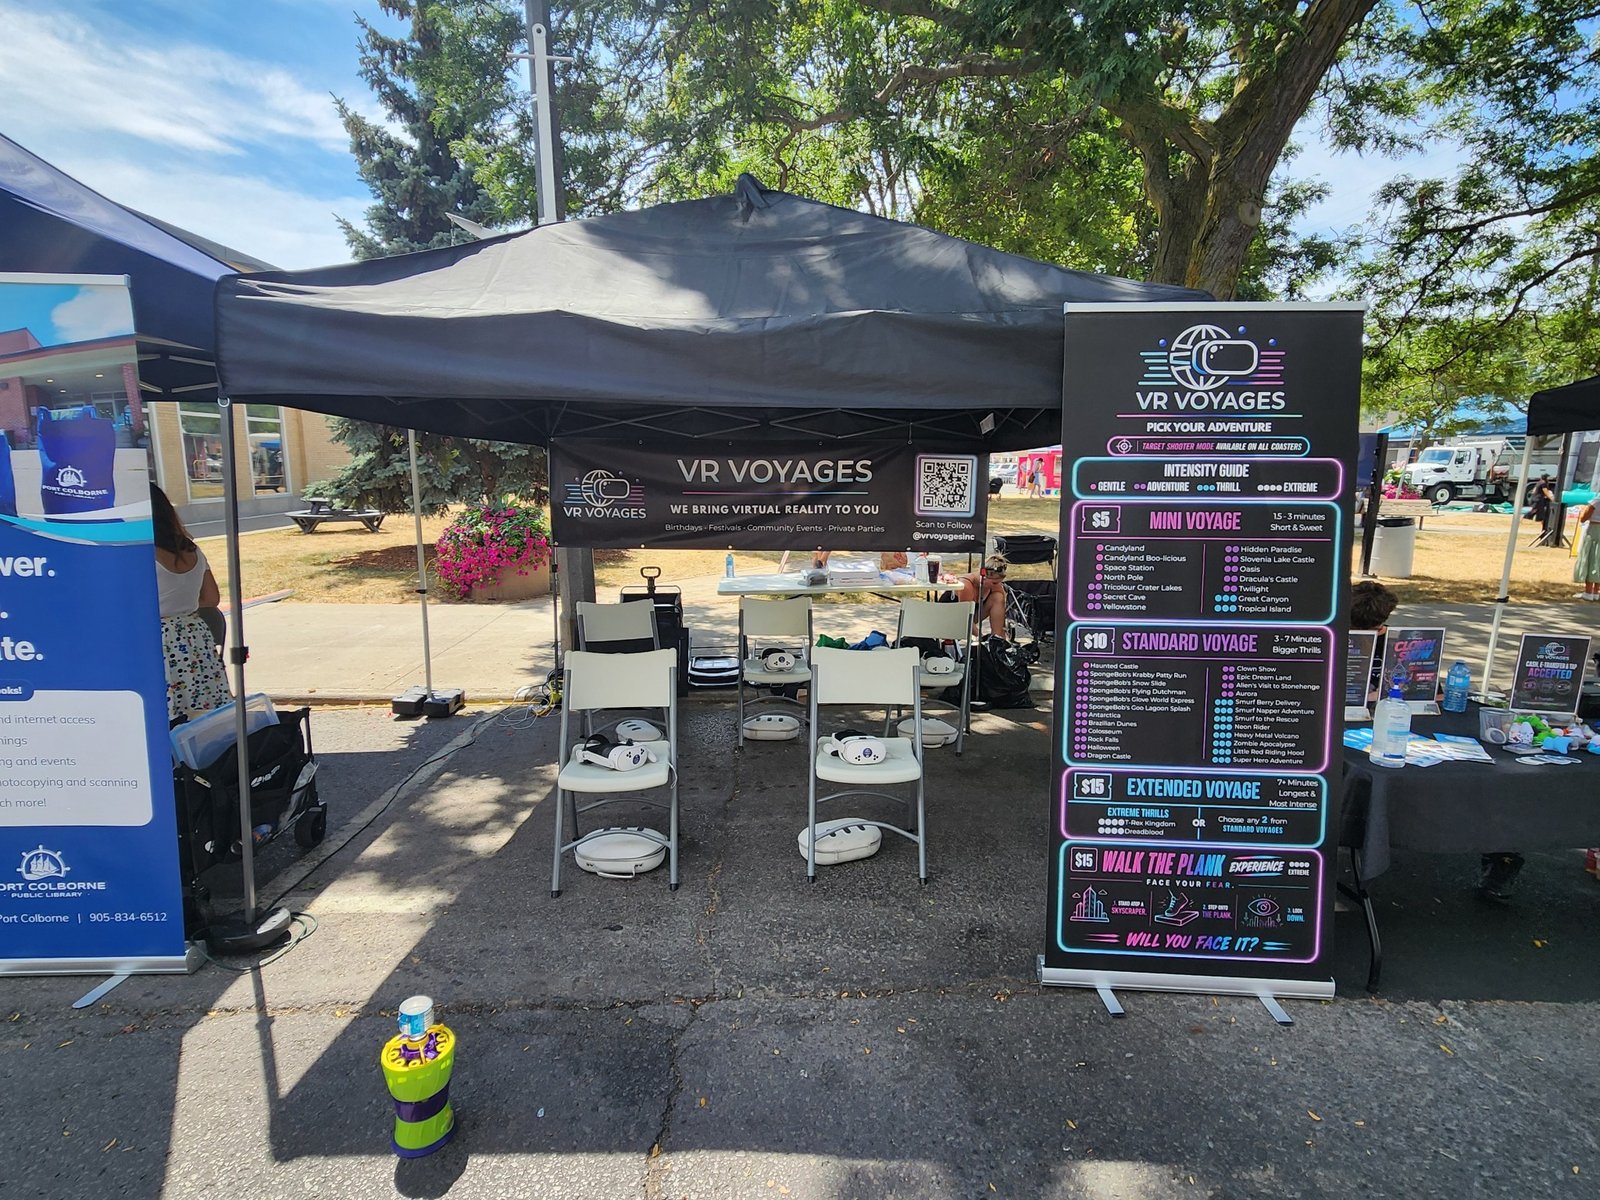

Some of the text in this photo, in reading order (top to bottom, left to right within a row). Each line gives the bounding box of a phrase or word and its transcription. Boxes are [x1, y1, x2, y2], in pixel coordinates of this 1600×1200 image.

[1135, 391, 1285, 409] VR VOYAGES
[1146, 422, 1272, 432] PICK YOUR ADVENTURE
[1142, 442, 1302, 450] TARGET SHOOTER MODE AVAILABLE ON ALL COASTERS
[677, 459, 872, 483] VR VOYAGES
[1164, 463, 1249, 477] INTENSITY GUIDE
[1098, 481, 1318, 492] GENTLE ADVENTURE THRILL EXTREME
[563, 506, 646, 519] VR VOYAGES
[670, 504, 879, 514] WE BRING VIRTUAL REALITY TO YOU
[1092, 511, 1110, 527] $5
[1149, 511, 1241, 529] MINI VOYAGE
[1287, 512, 1292, 520] 3
[1293, 512, 1325, 520] minutes
[665, 523, 702, 534] Birthdays
[747, 523, 794, 532] Community
[796, 523, 822, 531] Events
[828, 524, 856, 532] Private
[857, 524, 885, 532] Parties
[915, 520, 935, 528] Scan
[946, 521, 972, 529] Follow
[1270, 523, 1291, 531] Short
[1298, 523, 1323, 531] Sweet
[912, 531, 975, 541] @vrvoyagesinc
[1104, 544, 1145, 552] Candyland
[1103, 554, 1144, 562] Candyland
[1275, 575, 1298, 583] Castle
[1238, 585, 1269, 593] Twilight
[1260, 595, 1289, 603] Canyon
[1237, 604, 1267, 612] Tropical
[1083, 632, 1107, 649] $10
[1122, 632, 1258, 652] STANDARD VOYAGE
[1272, 645, 1298, 654] Bigger
[1089, 670, 1131, 678] SpongeBob's
[1132, 671, 1155, 679] Krabby
[1155, 671, 1173, 679] Patty
[1528, 668, 1572, 679] ACCEPTED
[1274, 699, 1301, 707] Delivery
[13, 714, 96, 724] internet access
[65, 777, 138, 789] and scanning
[1081, 778, 1104, 794] $15
[1288, 779, 1319, 787] Minutes
[1127, 778, 1260, 799] EXTENDED VOYAGE
[15, 798, 46, 807] more!
[1107, 808, 1169, 818] EXTREME THRILLS
[1192, 818, 1206, 828] OR
[1218, 815, 1245, 824] Choose
[1246, 817, 1260, 826] any
[1261, 815, 1268, 823] 2
[1222, 825, 1283, 834] STANDARD VOYAGES
[1075, 852, 1093, 867] $15
[1102, 850, 1226, 876] WALK THE PLANK
[1228, 861, 1285, 874] EXPERIENCE
[1287, 868, 1309, 876] EXTREME
[28, 881, 106, 890] COLBORNE
[1146, 878, 1170, 886] FACE
[1175, 879, 1201, 887] YOUR
[1111, 906, 1146, 915] SKYSCRAPER.
[1202, 910, 1232, 919] THE PLANK.
[20, 913, 69, 922] Colborne
[89, 912, 167, 922] 905-834-6512
[1286, 914, 1304, 922] DOWN.
[1126, 931, 1259, 951] WILL YOU FACE IT?
